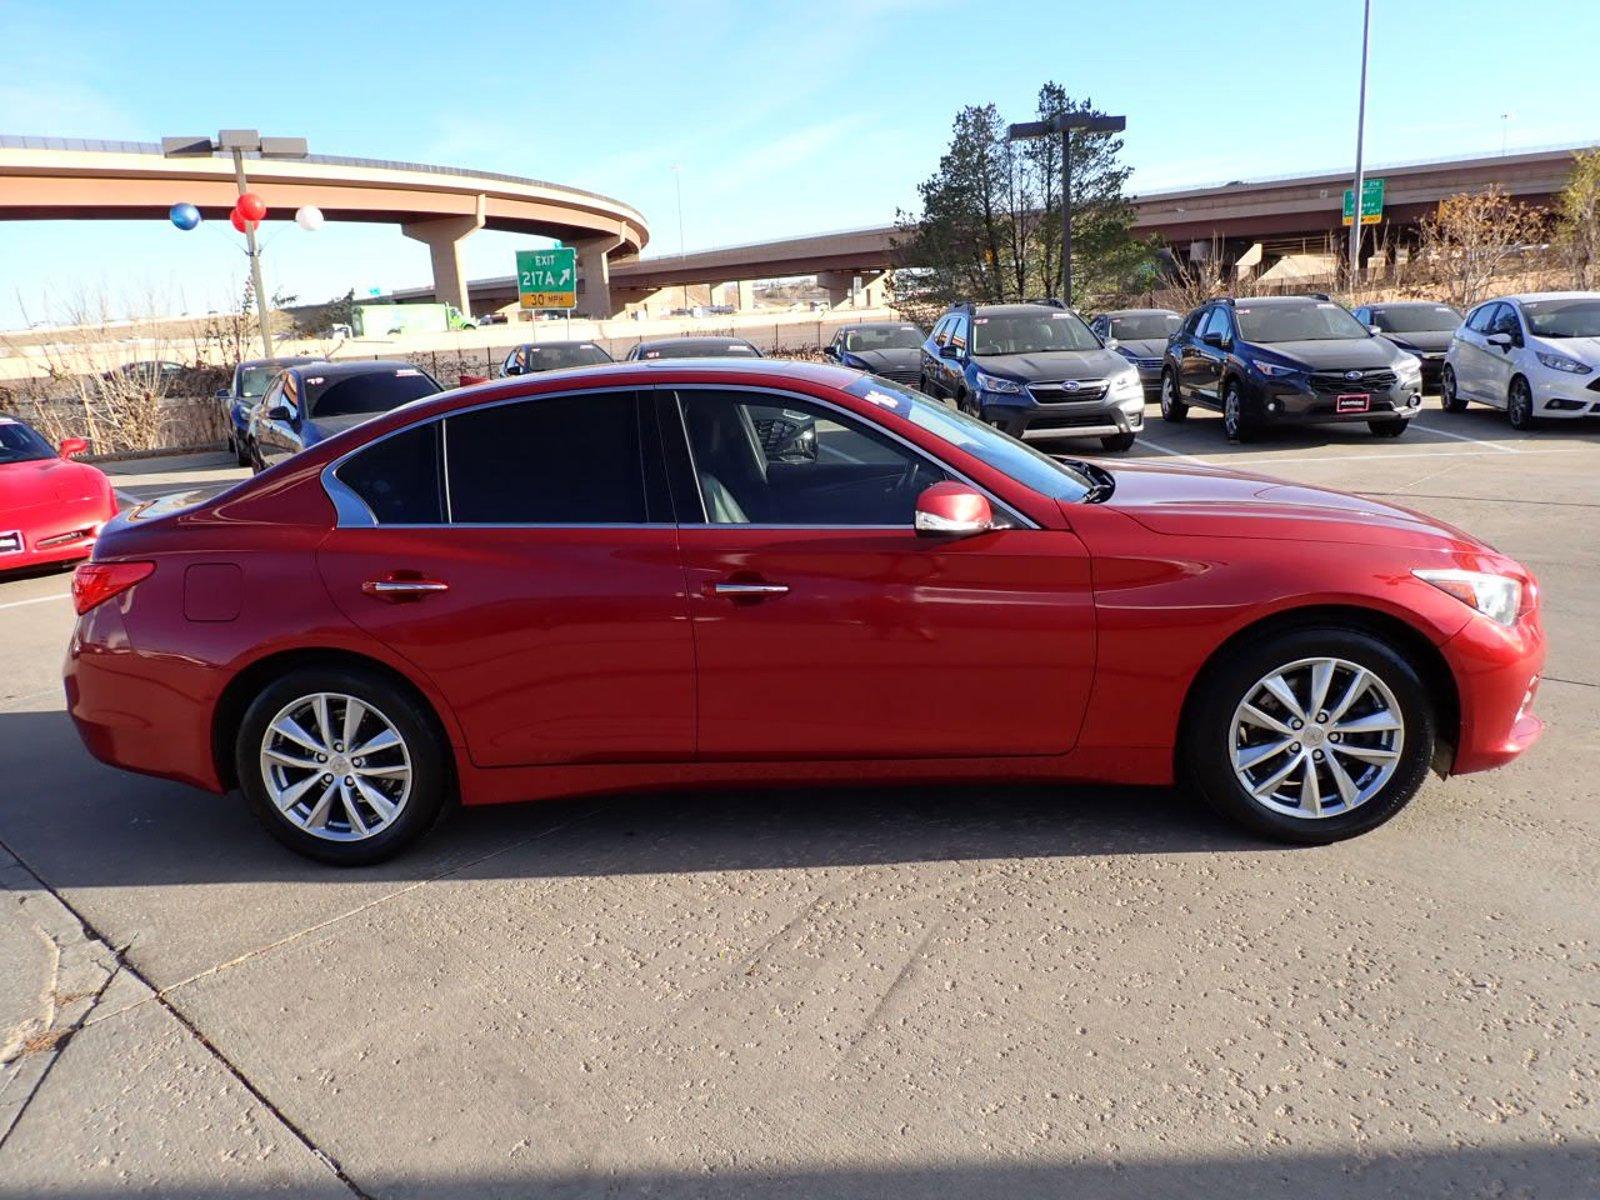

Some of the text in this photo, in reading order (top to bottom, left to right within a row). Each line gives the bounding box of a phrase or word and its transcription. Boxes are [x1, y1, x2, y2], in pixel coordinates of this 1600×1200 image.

[535, 255, 555, 266] EXIT
[522, 271, 554, 286] 217A
[530, 294, 564, 305] 30 MPH
